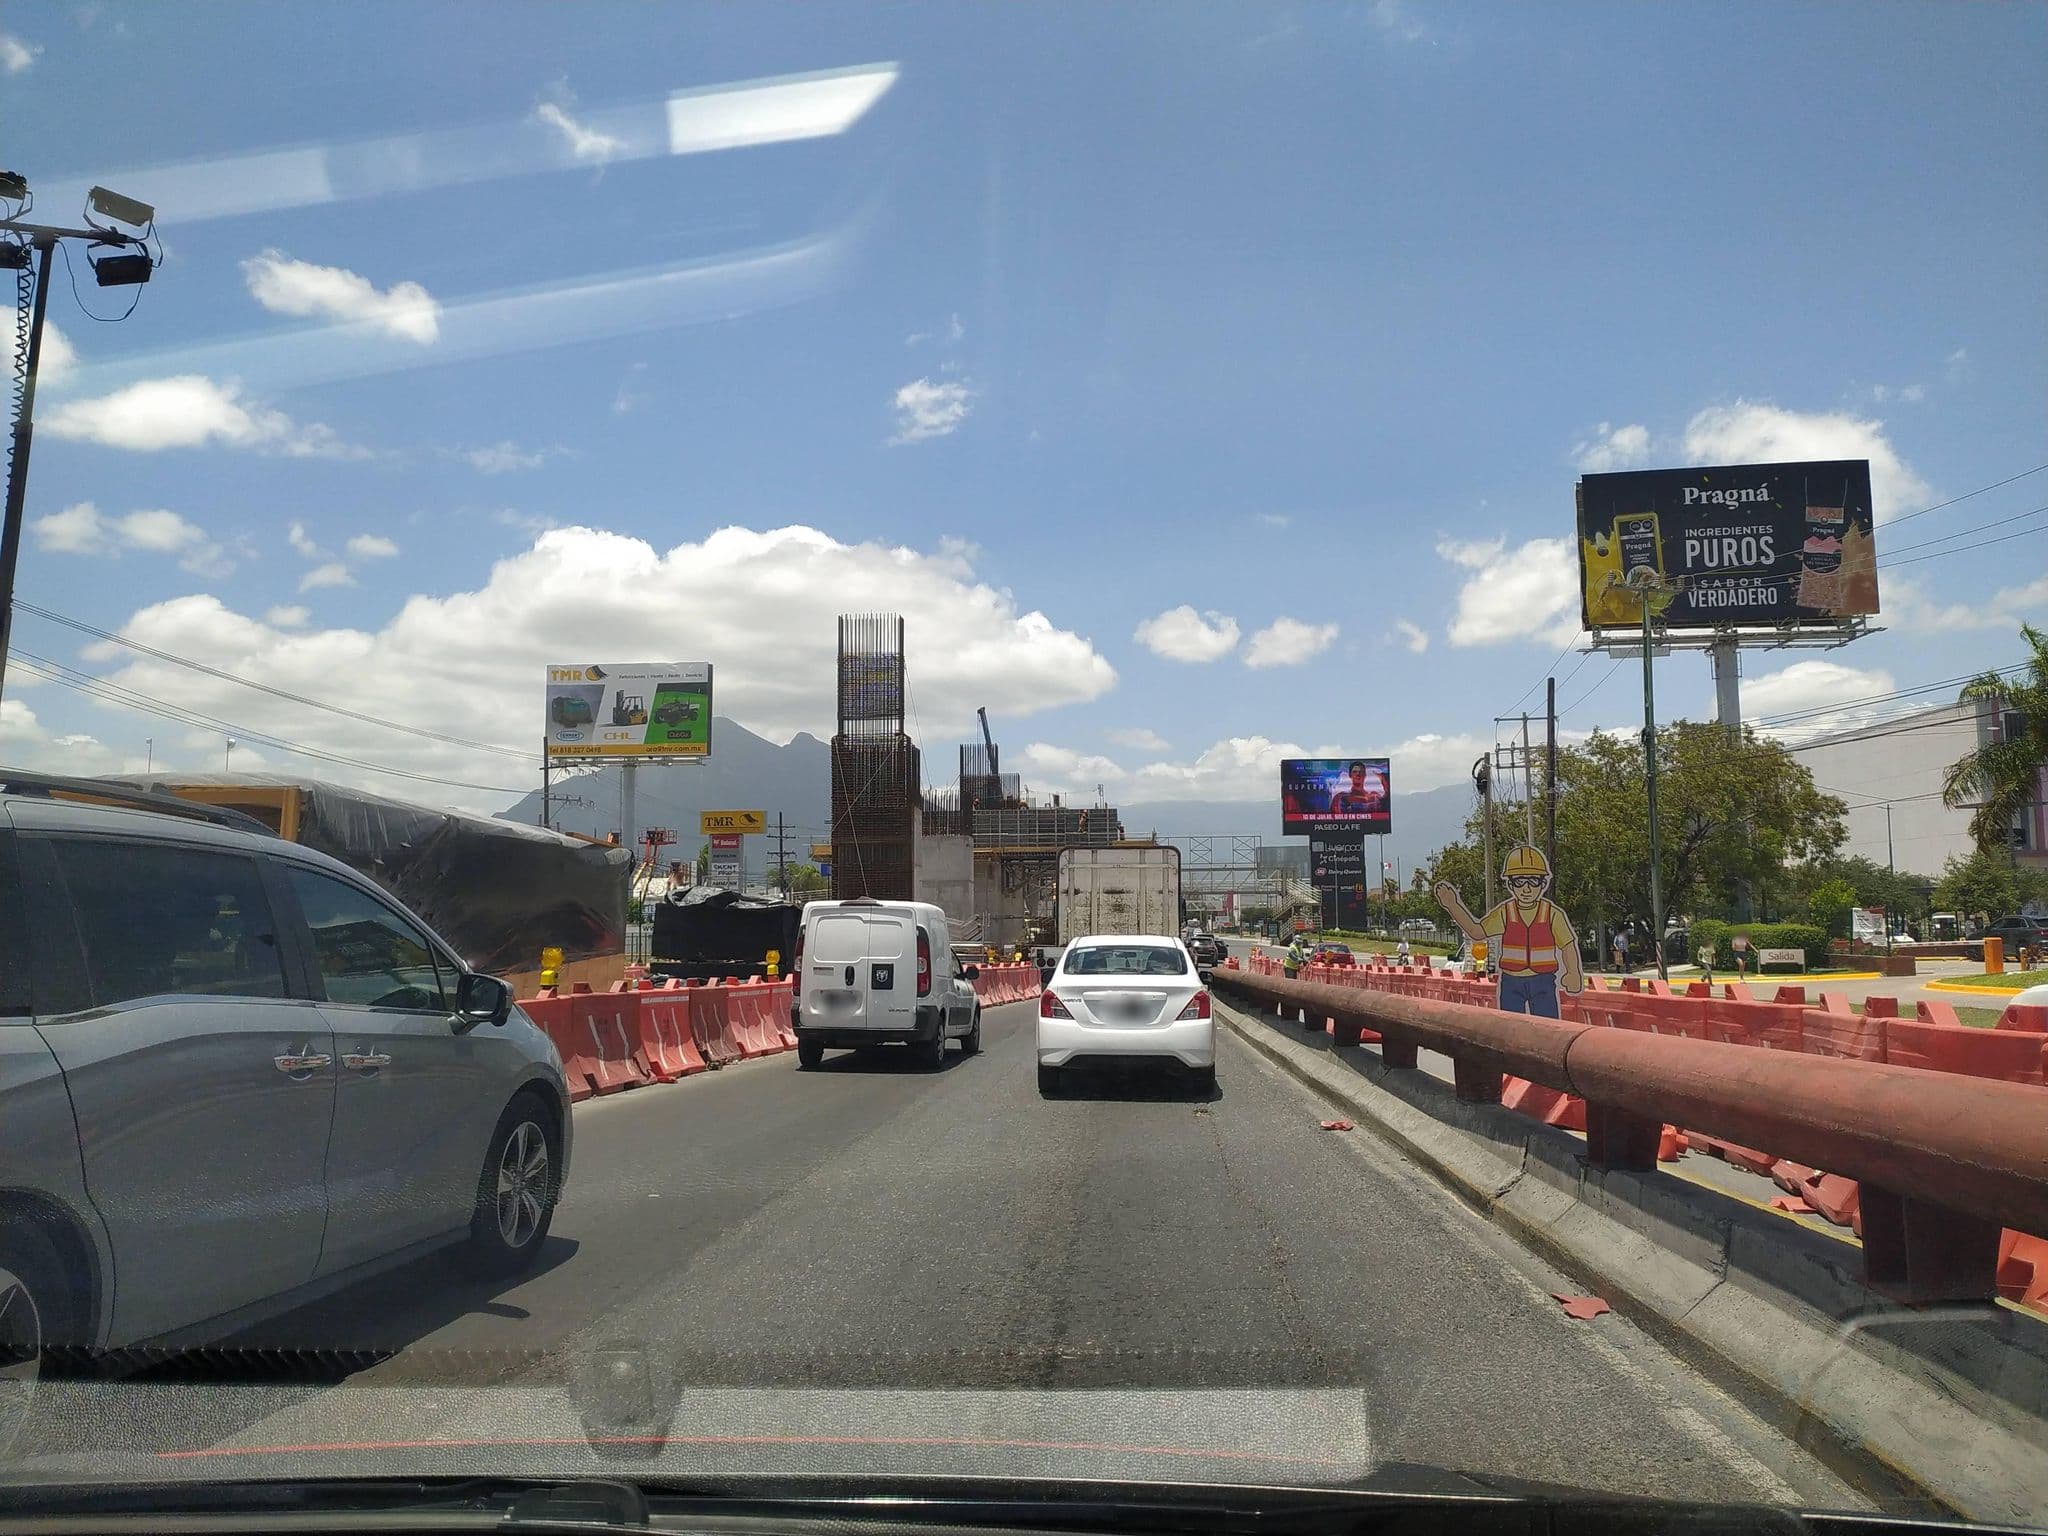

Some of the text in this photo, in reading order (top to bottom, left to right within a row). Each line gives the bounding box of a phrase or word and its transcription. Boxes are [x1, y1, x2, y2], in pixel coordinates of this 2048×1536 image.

[1682, 482, 1770, 510] Pragná
[1685, 525, 1774, 537] INGREDIENTES
[1685, 536, 1775, 568] PUROS
[1700, 578, 1762, 588] SABOR
[1688, 587, 1778, 608] VERDADERO
[551, 670, 582, 681] TMR
[704, 816, 734, 826] TMR
[1314, 823, 1361, 831] PASEO LA FE
[1768, 951, 1795, 961] Salida
